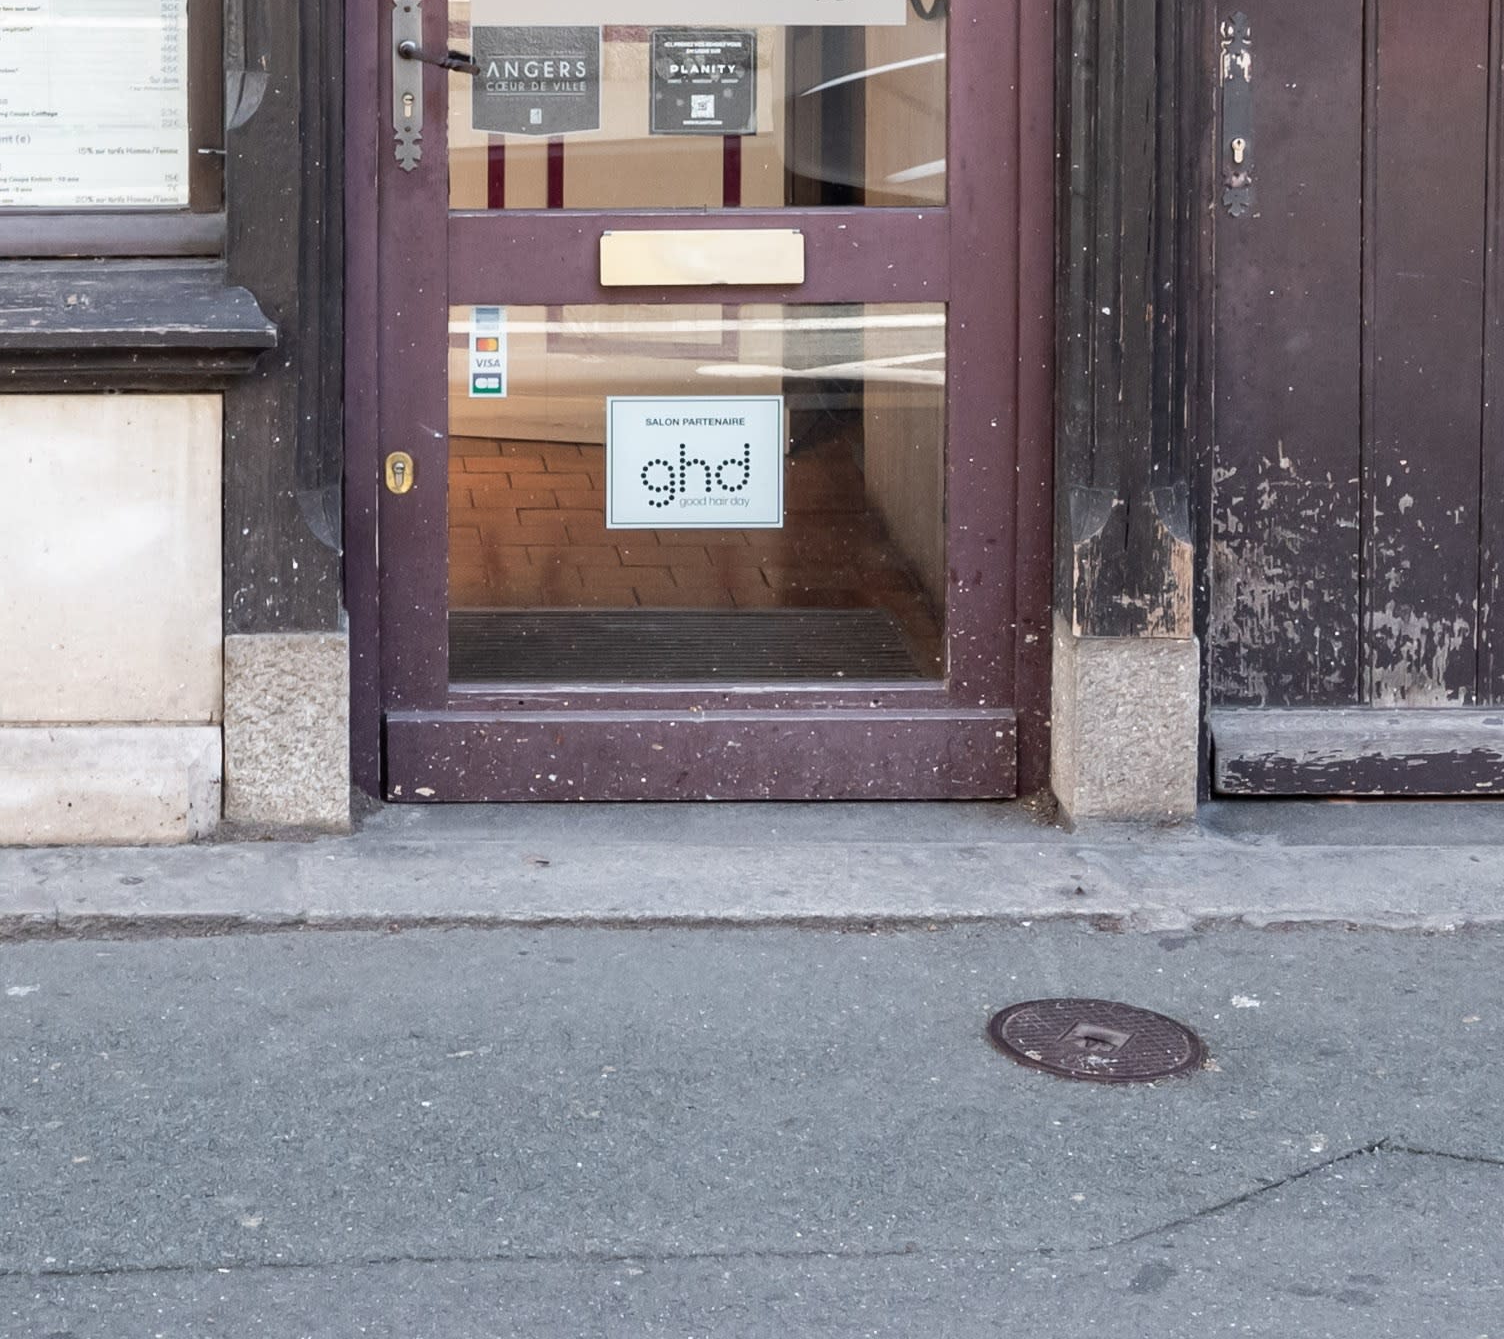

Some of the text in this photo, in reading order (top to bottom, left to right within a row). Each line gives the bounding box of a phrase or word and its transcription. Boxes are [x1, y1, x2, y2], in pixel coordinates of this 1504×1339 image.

[486, 60, 587, 78] ANGERS
[669, 64, 736, 74] PLANITY
[531, 81, 548, 92] DE
[553, 81, 587, 92] VILLE
[476, 358, 501, 369] VISA
[645, 417, 745, 427] SALON PARTENAIRE
[640, 442, 751, 508] ghd
[679, 495, 750, 508] good hair day
